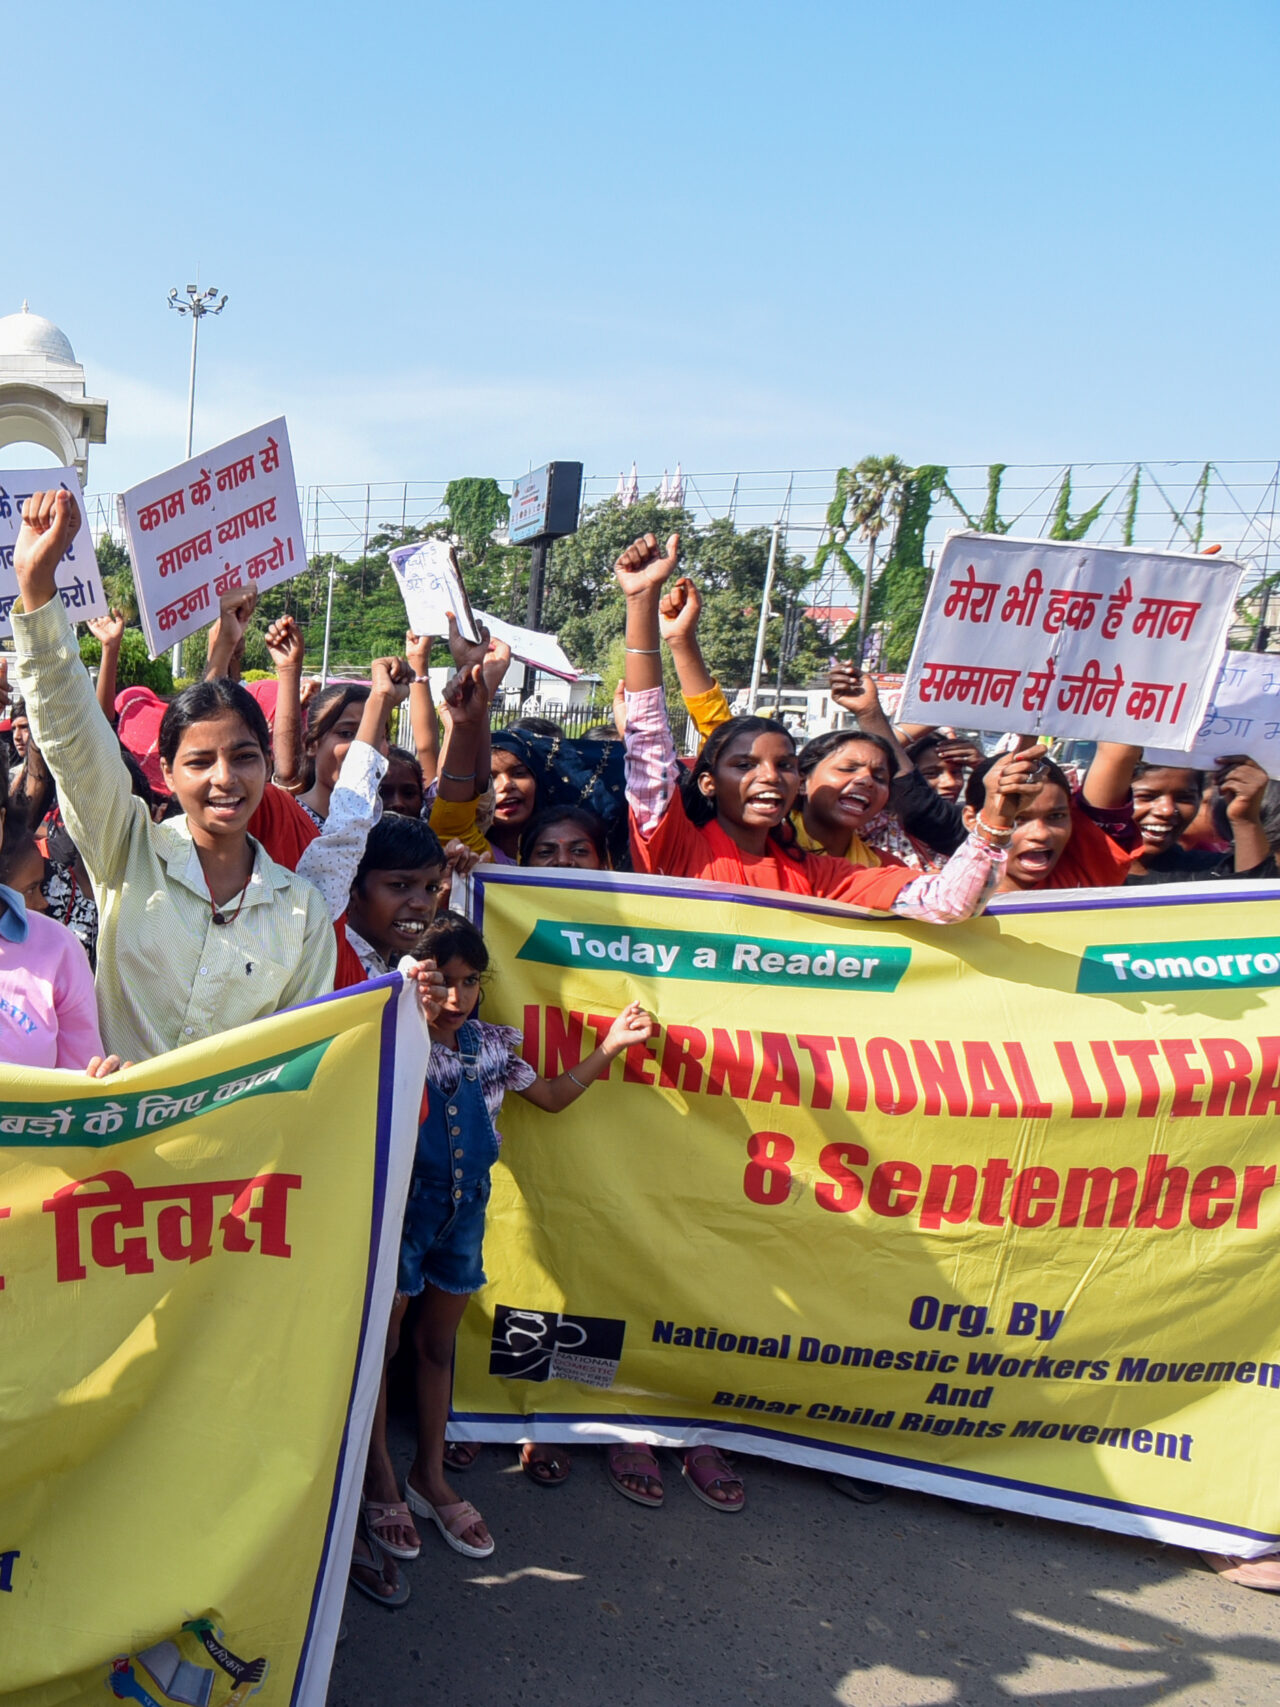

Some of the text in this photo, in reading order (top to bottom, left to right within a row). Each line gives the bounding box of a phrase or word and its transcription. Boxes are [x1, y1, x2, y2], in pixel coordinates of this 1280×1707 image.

[137, 436, 280, 532] काम के नाम से
[156, 496, 277, 578] मानव व्यापार
[156, 582, 211, 632] करना
[943, 564, 1202, 642] मेरा भी हक है मान
[919, 662, 1021, 708] सम्मान
[1022, 657, 1055, 712] से
[1057, 659, 1124, 718] जीने
[560, 930, 880, 979] Today a Reader
[1102, 951, 1280, 981] Tomorro
[522, 1004, 1053, 1119] INTERNATIONAL
[0, 1062, 289, 1138] बड़ों के लिए काम
[743, 1130, 1277, 1230] 8 September
[42, 1170, 303, 1284] दिवस
[652, 1320, 790, 1359] National
[797, 1337, 959, 1374] Domestic
[965, 1352, 1108, 1382] Workers
[909, 1295, 1066, 1341] Org. By
[711, 1390, 1195, 1462] Bihar Child Rights Movement
[926, 1382, 994, 1408] And
